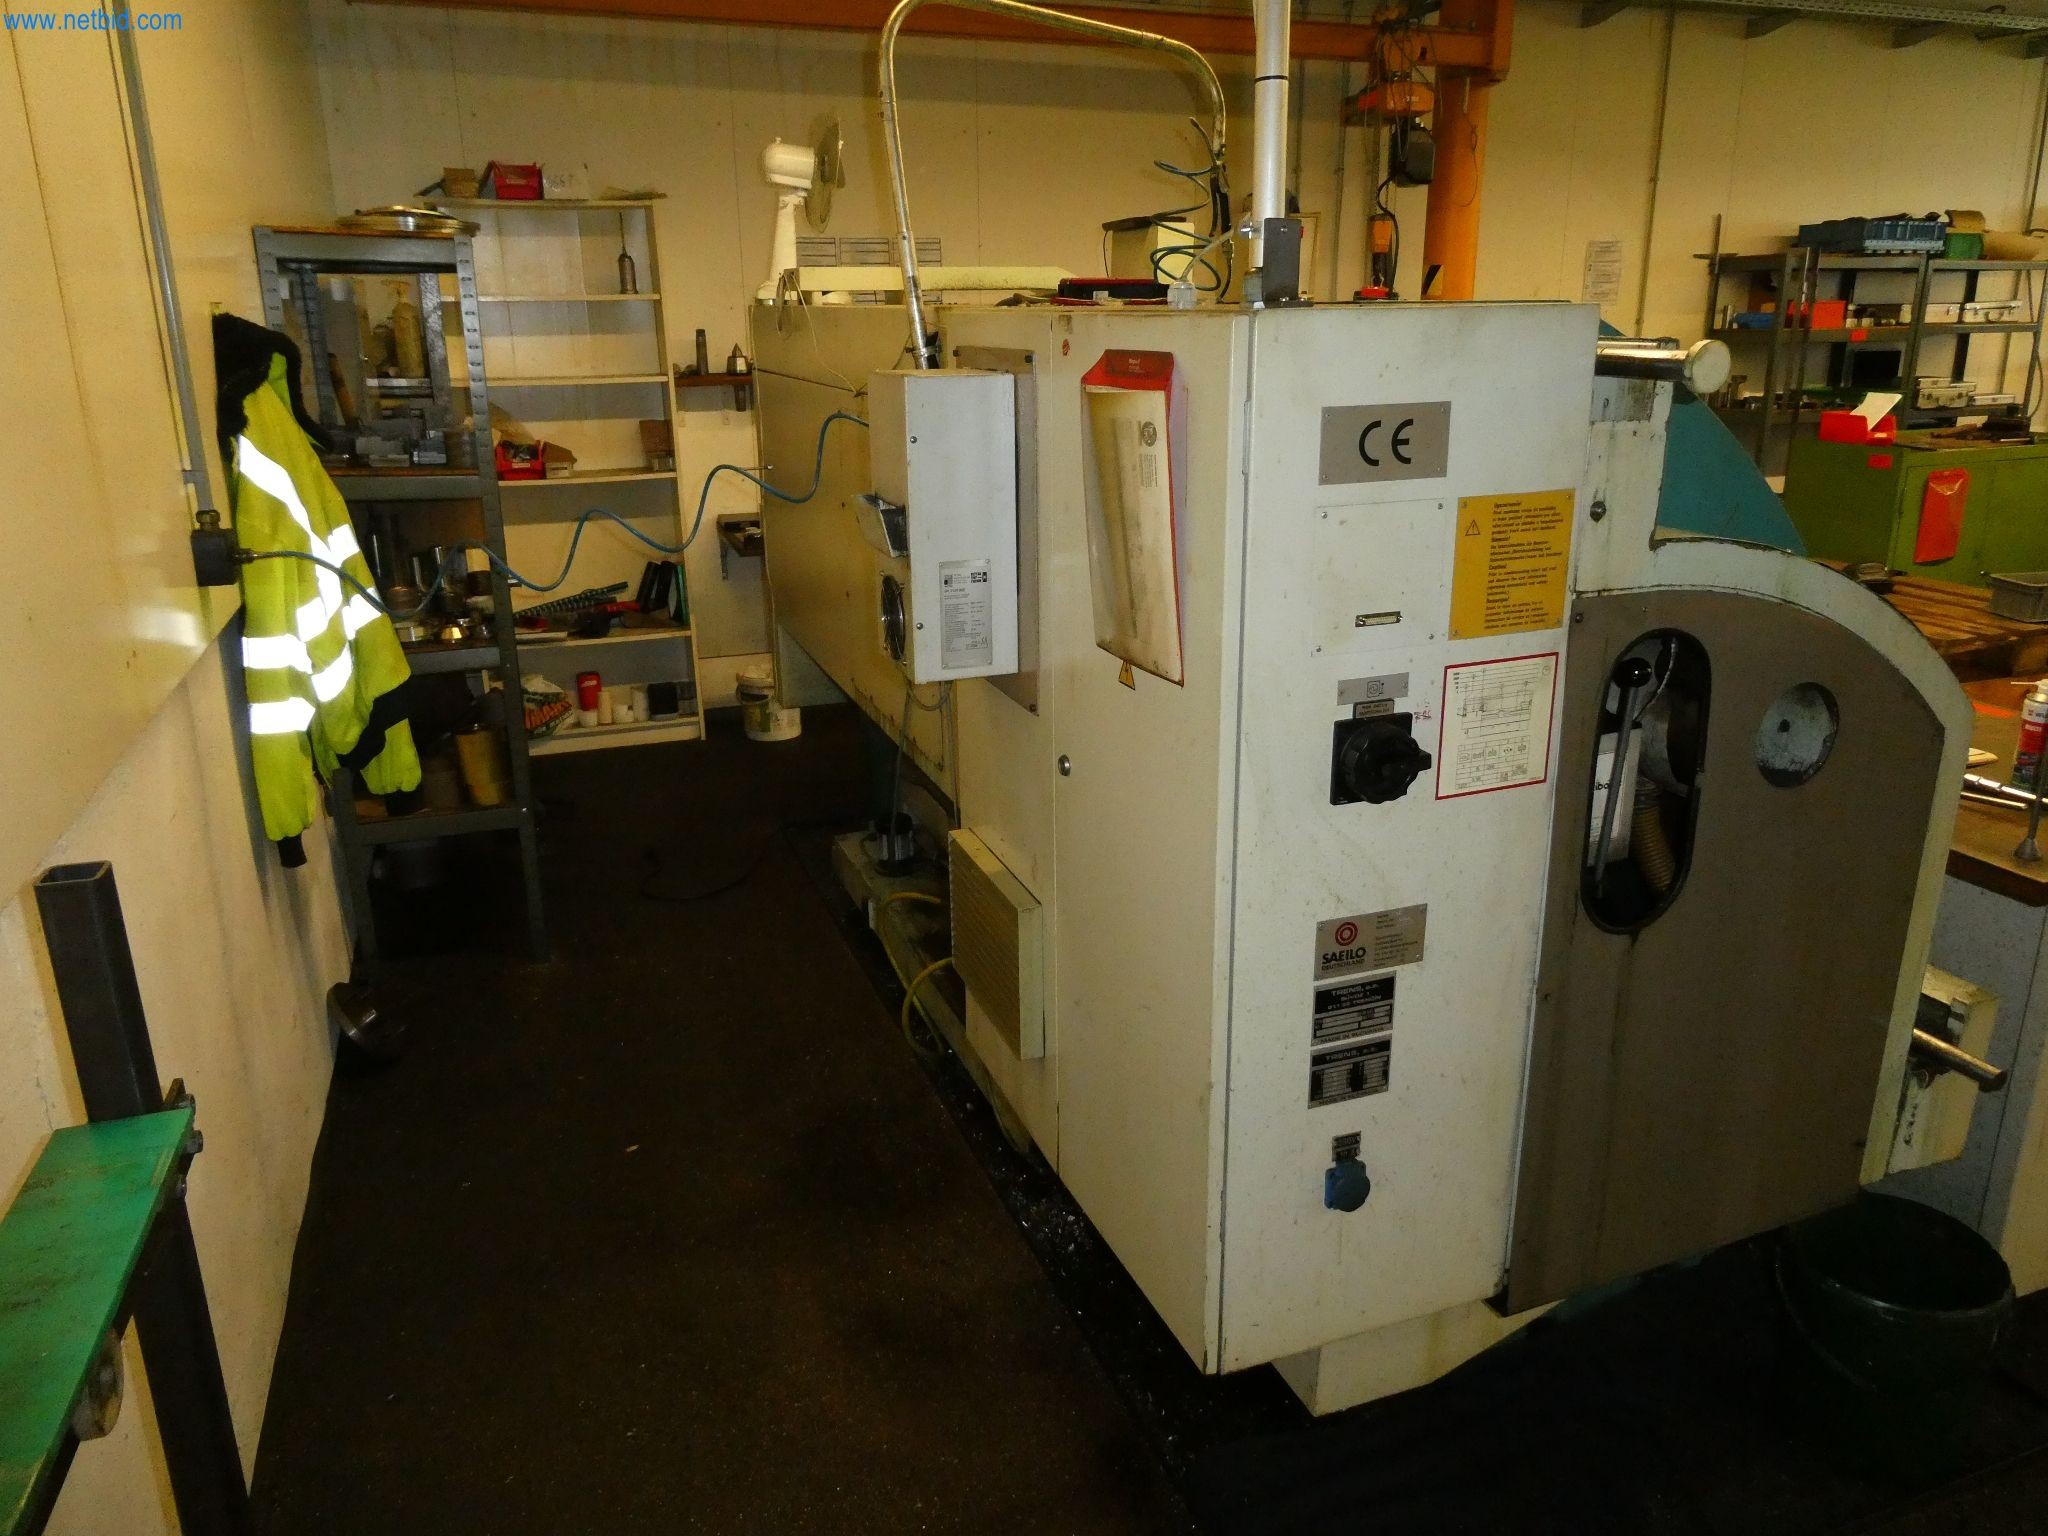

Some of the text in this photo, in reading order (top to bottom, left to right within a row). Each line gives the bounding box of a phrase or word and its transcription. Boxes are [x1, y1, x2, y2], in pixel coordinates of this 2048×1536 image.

[1359, 418, 1414, 467] CE
[1321, 947, 1367, 964] SAEILO
[1321, 958, 1366, 971] DEUTSCHLAND
